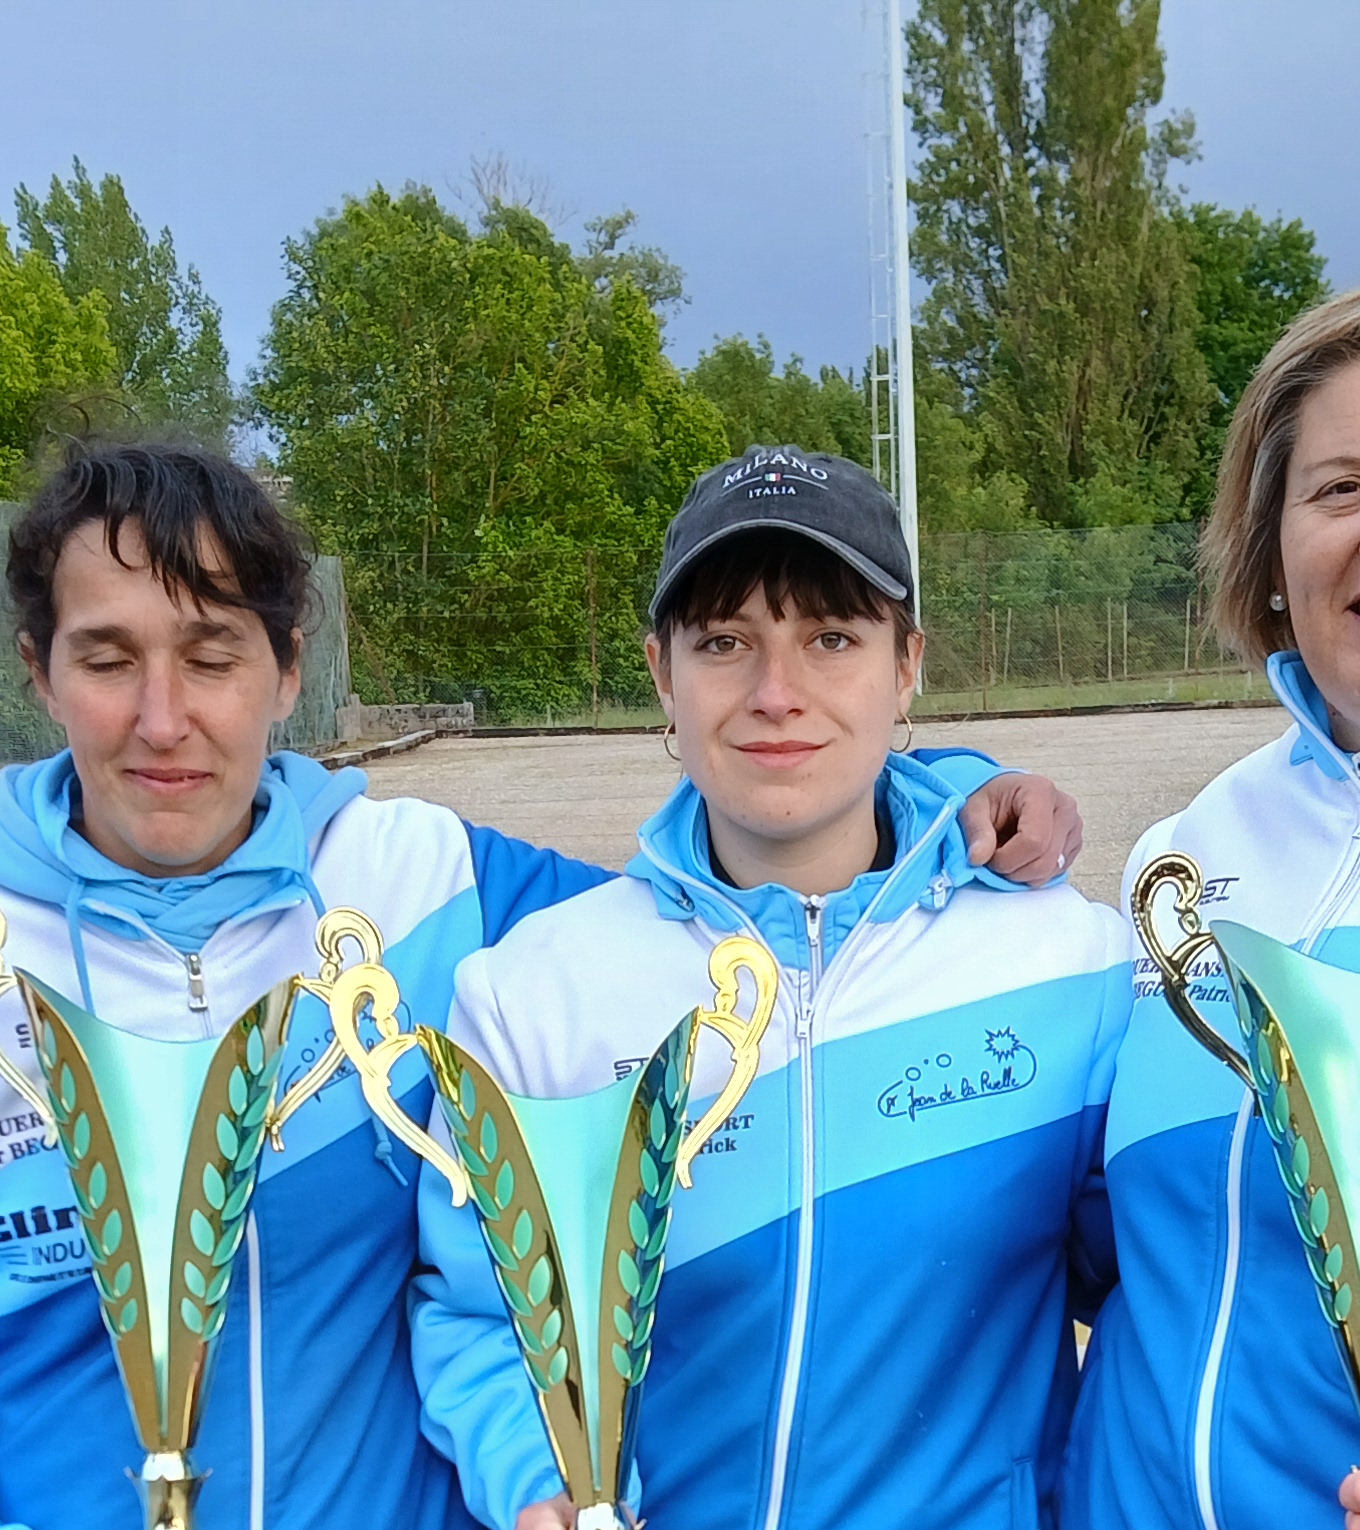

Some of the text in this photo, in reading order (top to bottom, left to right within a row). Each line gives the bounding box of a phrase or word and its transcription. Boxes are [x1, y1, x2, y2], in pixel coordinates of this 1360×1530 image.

[722, 453, 829, 489] MILANO
[748, 485, 797, 499] ITALIA
[939, 1083, 957, 1102] de
[980, 1065, 1020, 1093] Ruelle
